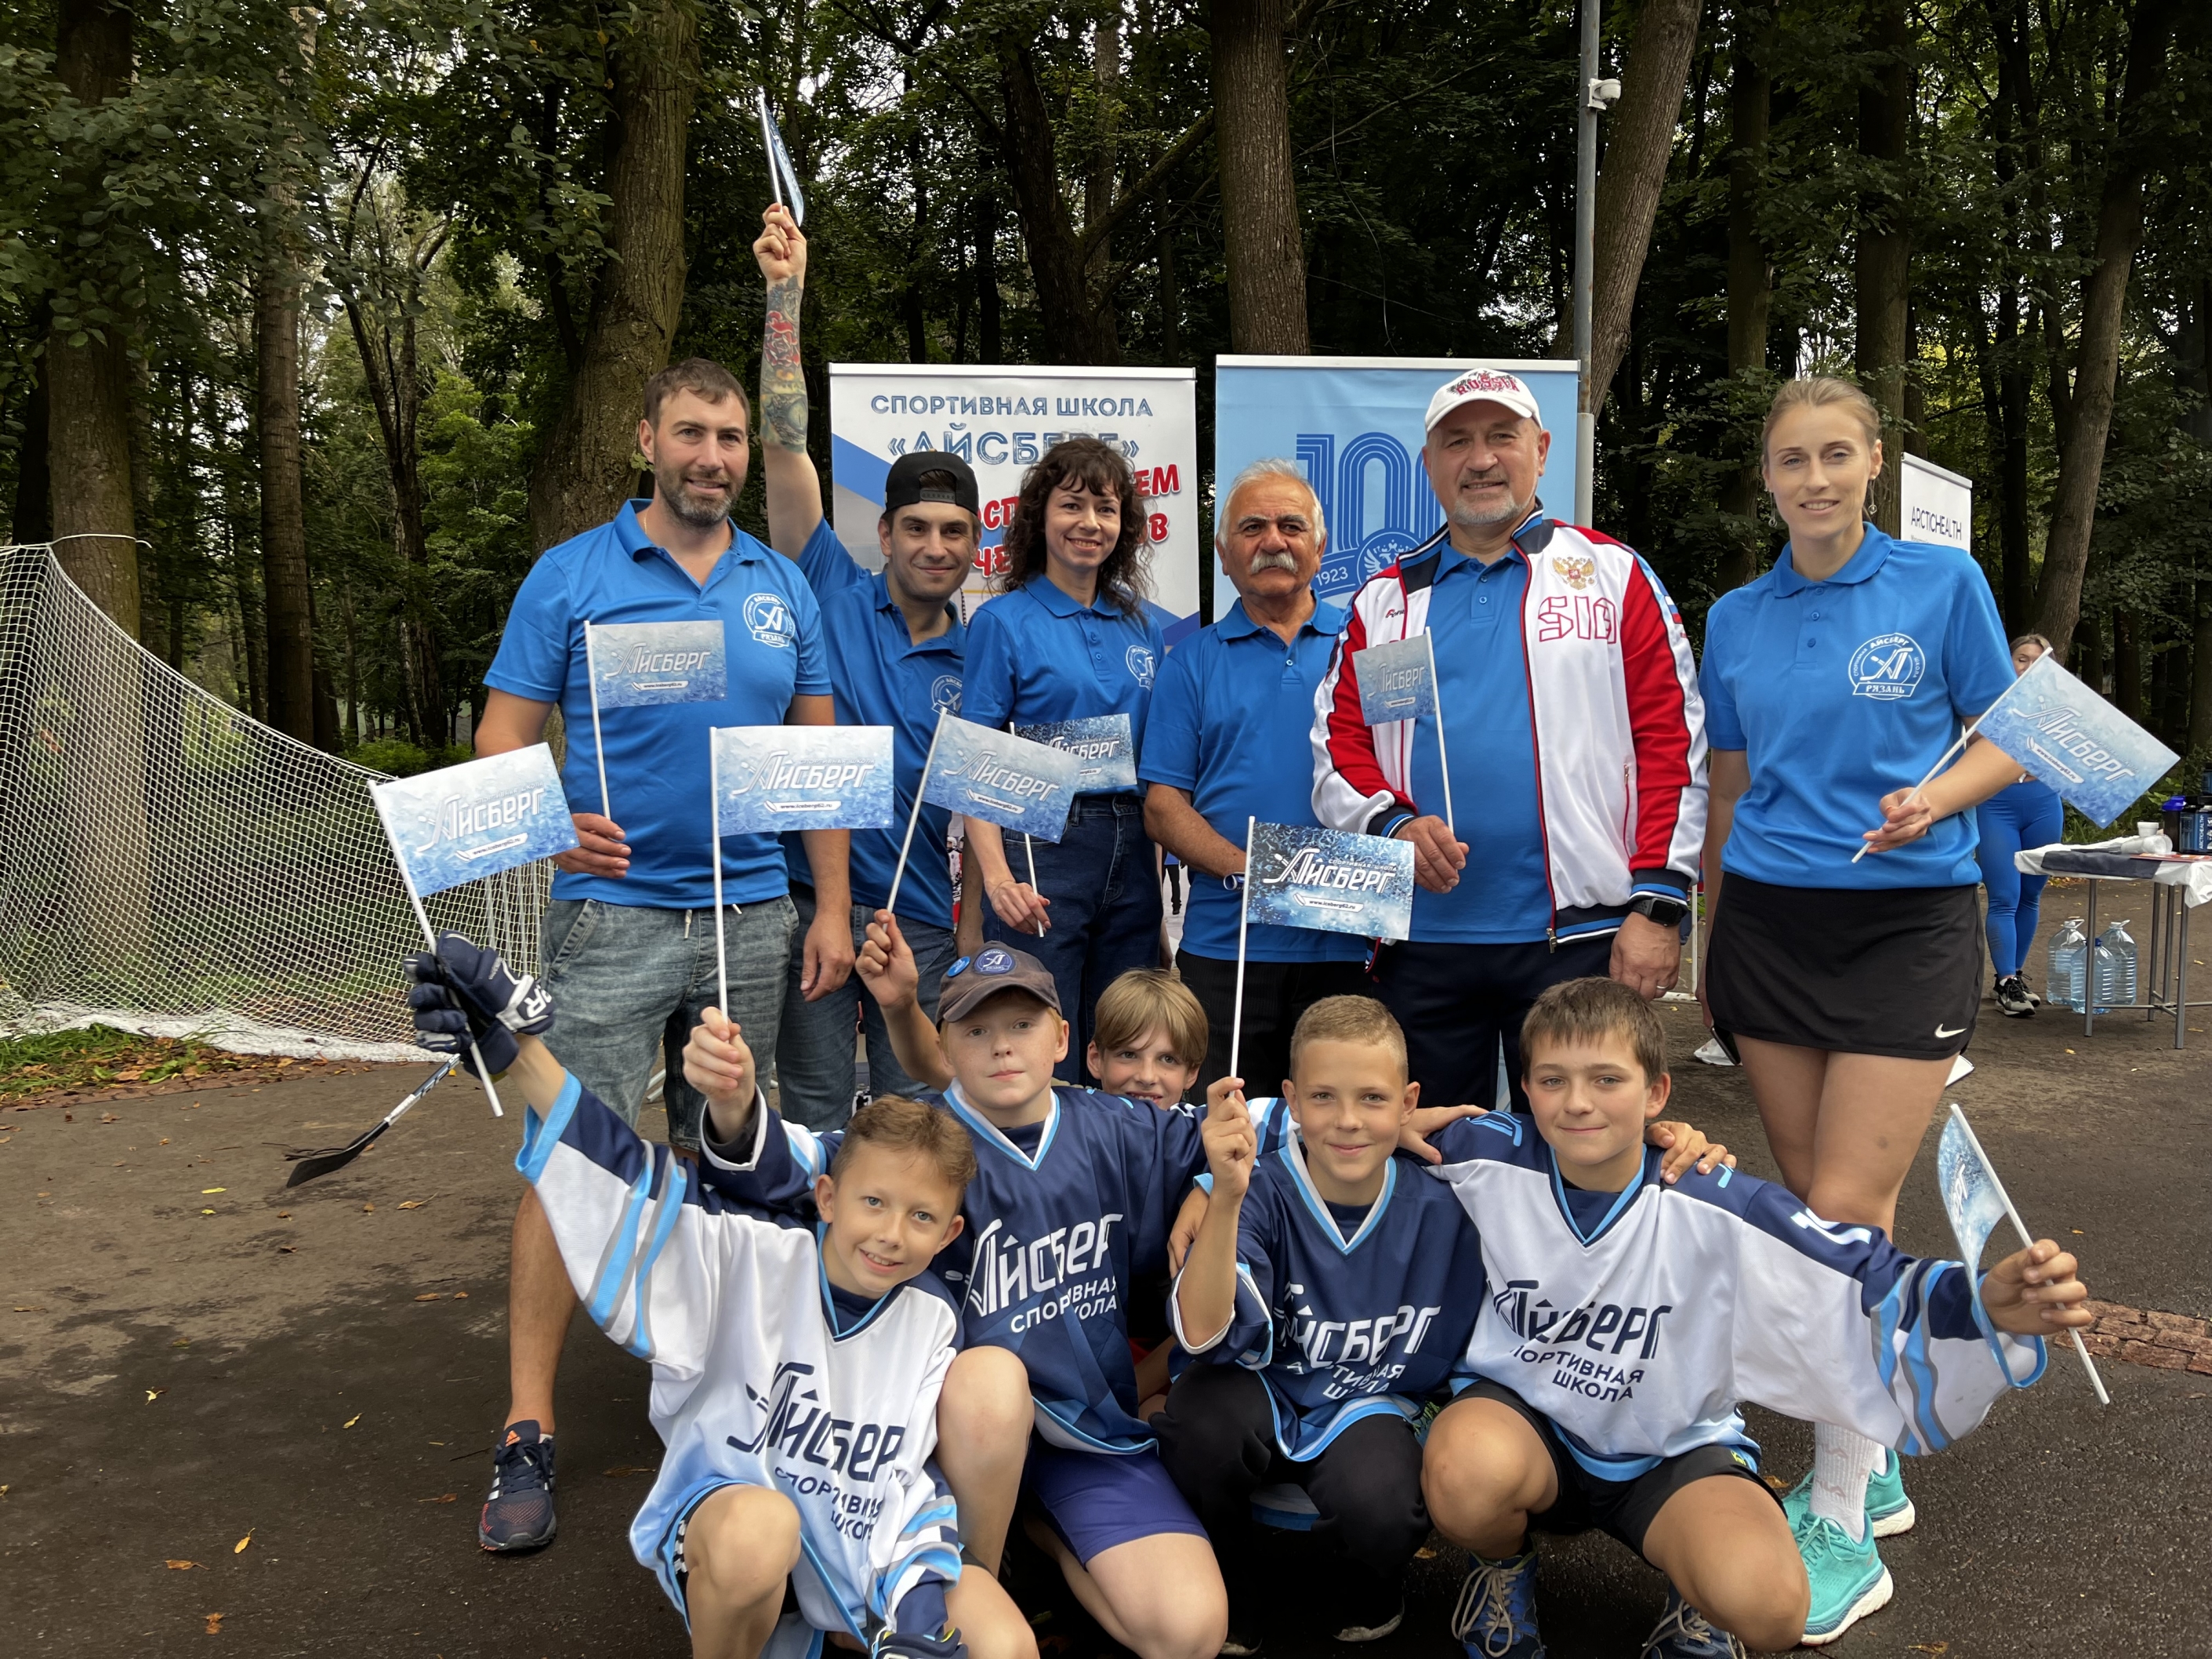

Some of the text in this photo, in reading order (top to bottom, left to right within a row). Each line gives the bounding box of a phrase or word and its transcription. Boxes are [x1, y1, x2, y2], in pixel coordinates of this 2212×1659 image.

[1456, 372, 1521, 396] RUSSIA
[871, 394, 1154, 416] СПОРТИВНАЯ ШКОЛА
[1910, 506, 1962, 541] ARCTICHEALTH
[1315, 566, 1348, 586] 1923
[1870, 636, 1909, 649] АЙСБЕРГ
[1866, 684, 1906, 694] РЯЗАНЬ
[1328, 858, 1372, 869] СПОРТИВНАЯ
[1552, 1369, 1634, 1402] ШКОЛА
